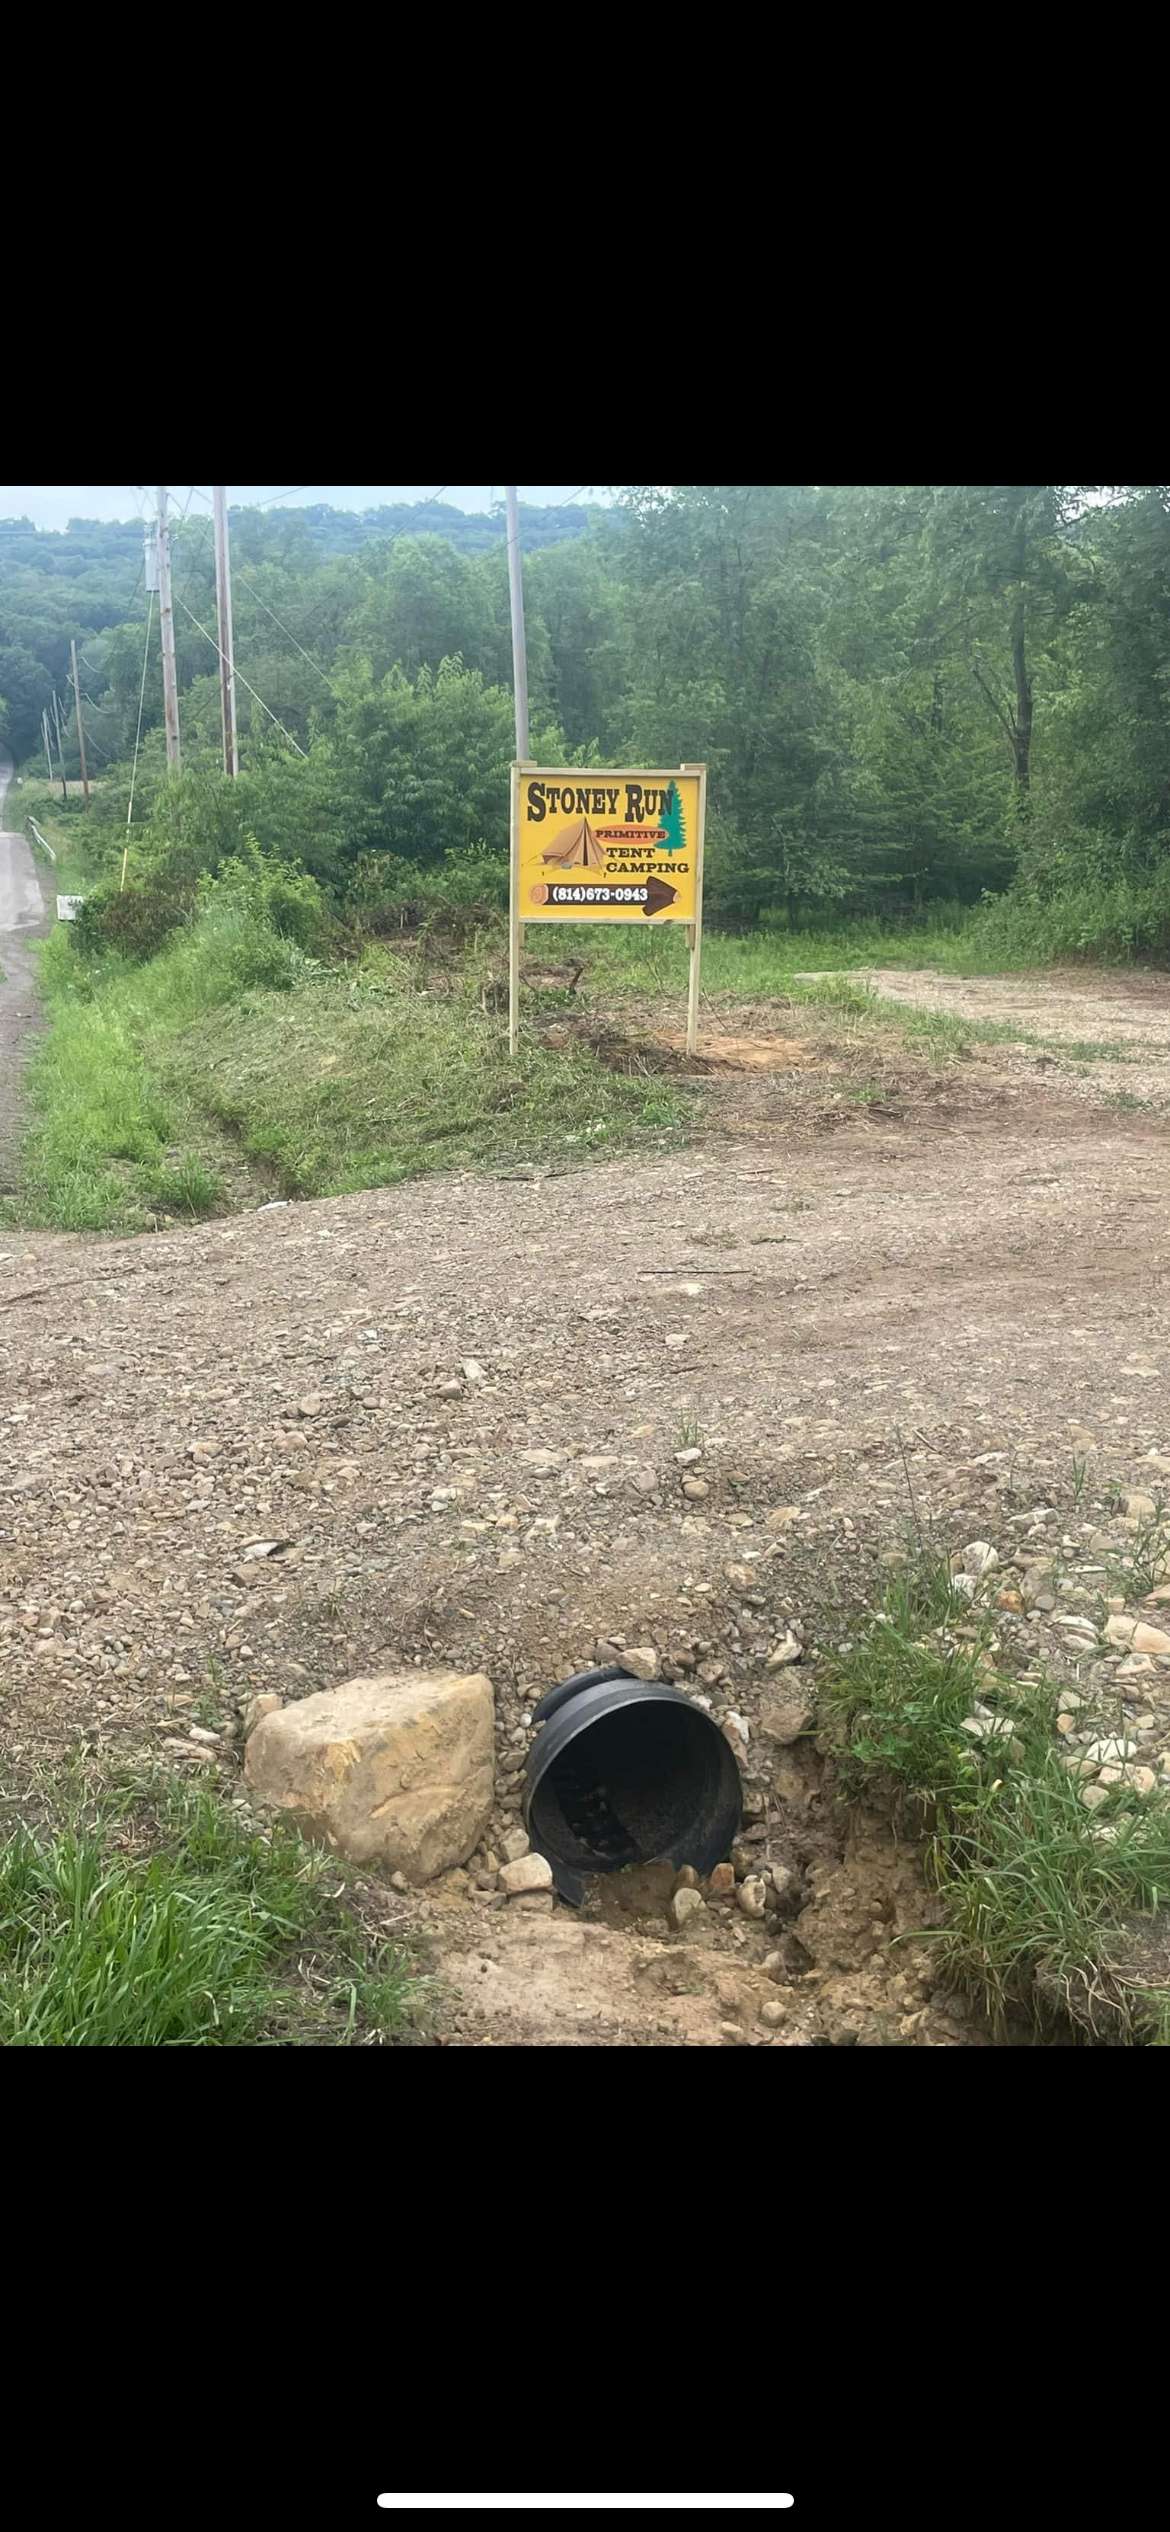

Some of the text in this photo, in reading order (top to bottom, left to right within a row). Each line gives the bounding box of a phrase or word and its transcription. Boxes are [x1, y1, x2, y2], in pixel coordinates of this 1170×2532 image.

[527, 782, 674, 823] STONEY RUN
[595, 829, 666, 839] PRIMITIVE
[606, 848, 656, 858] TENT
[606, 862, 689, 874] CAMPING
[552, 886, 648, 901] (814)673-0943
